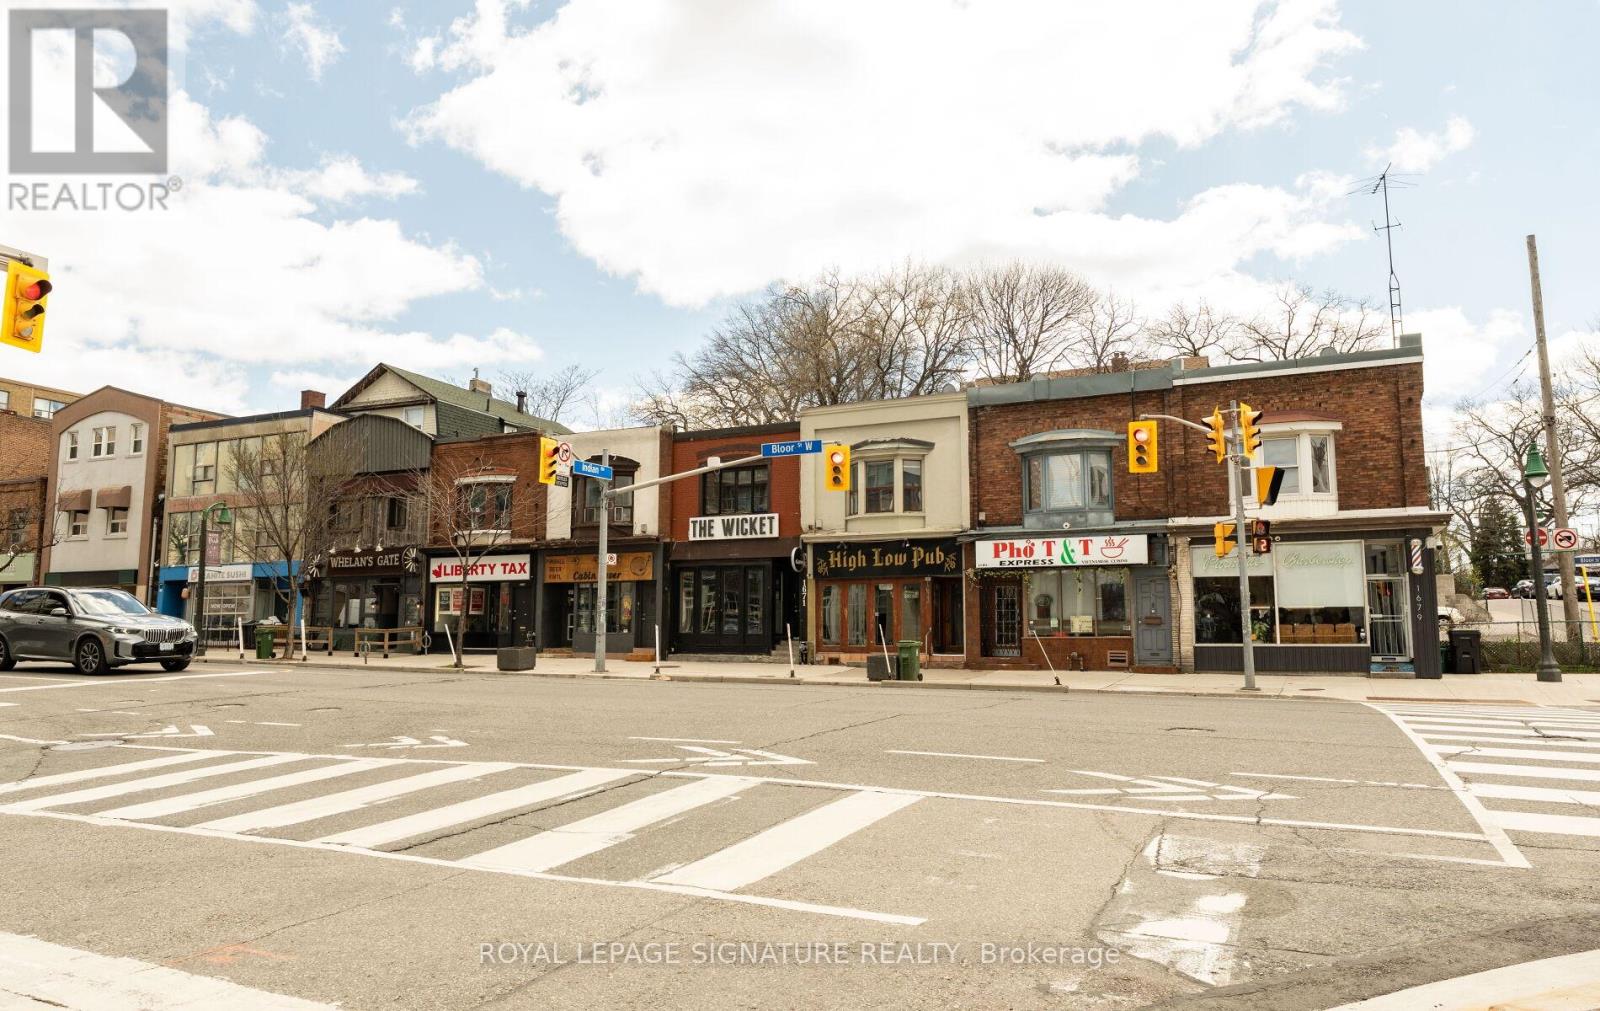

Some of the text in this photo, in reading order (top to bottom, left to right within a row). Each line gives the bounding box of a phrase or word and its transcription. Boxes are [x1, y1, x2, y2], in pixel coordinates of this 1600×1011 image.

[772, 444, 794, 454] Bloor
[804, 441, 812, 450] W
[691, 516, 774, 538] THE WICKET
[1042, 540, 1056, 557] T
[1060, 538, 1076, 564] &
[1078, 539, 1092, 556] T
[1260, 540, 1266, 551] 2
[330, 554, 400, 568] WHELAN'S GATE
[828, 546, 944, 572] High Low Pub
[501, 562, 527, 574] TAX
[573, 572, 598, 580] Cabin
